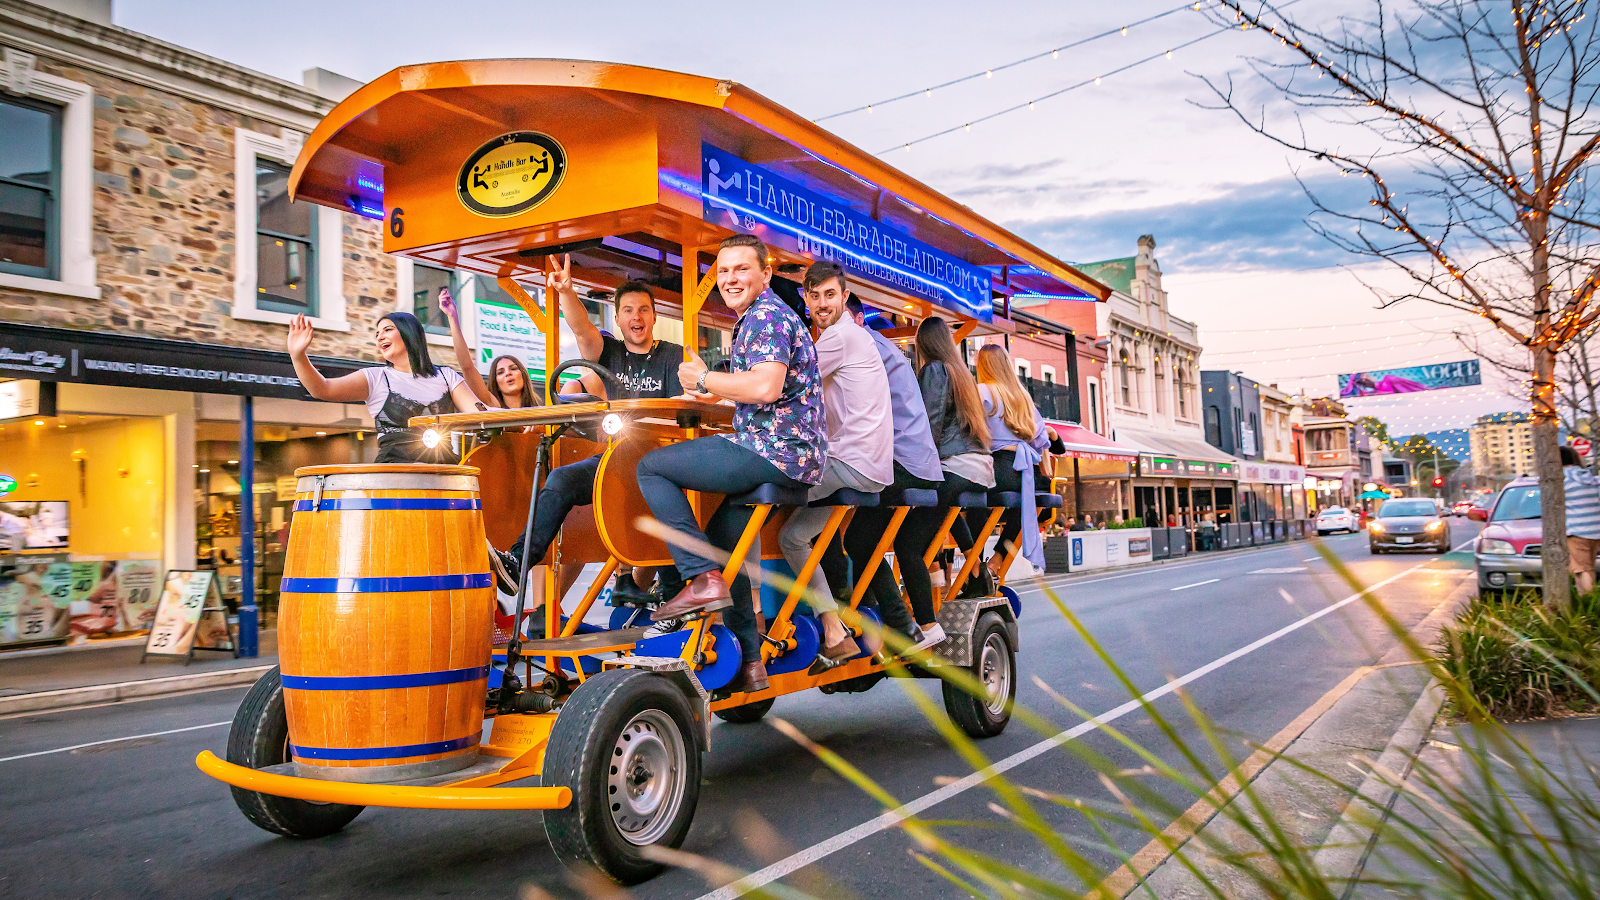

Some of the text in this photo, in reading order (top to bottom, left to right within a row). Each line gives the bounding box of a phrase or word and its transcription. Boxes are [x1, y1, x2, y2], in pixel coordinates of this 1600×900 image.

[494, 157, 527, 171] Handle Bar
[500, 188, 521, 197] Australia
[390, 207, 404, 237] 6
[479, 306, 498, 318] New
[499, 310, 517, 322] High
[480, 319, 500, 331] Food
[502, 323, 508, 332] &
[510, 324, 531, 336] Retail
[84, 359, 136, 373] WAXING
[142, 364, 222, 381] REFLEXOLOGY
[1421, 360, 1480, 379] VOGUE
[184, 594, 202, 609] 45
